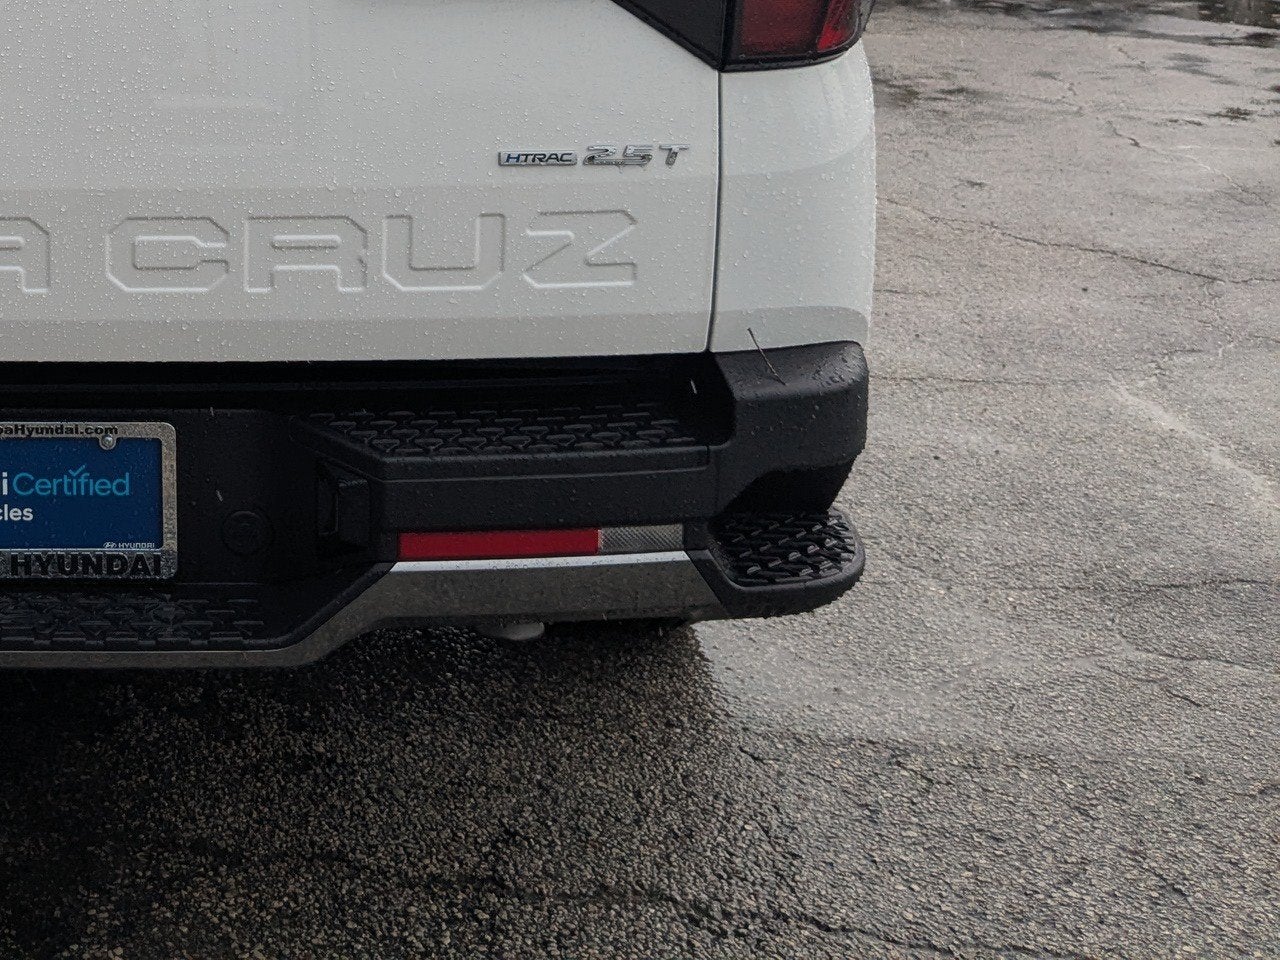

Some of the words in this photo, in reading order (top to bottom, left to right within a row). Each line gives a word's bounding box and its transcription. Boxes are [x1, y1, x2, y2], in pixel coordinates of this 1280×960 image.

[505, 152, 573, 163] HTRAC
[106, 209, 637, 293] CRUZ
[12, 466, 130, 496] Certified
[10, 552, 162, 577] HYUNDAI
